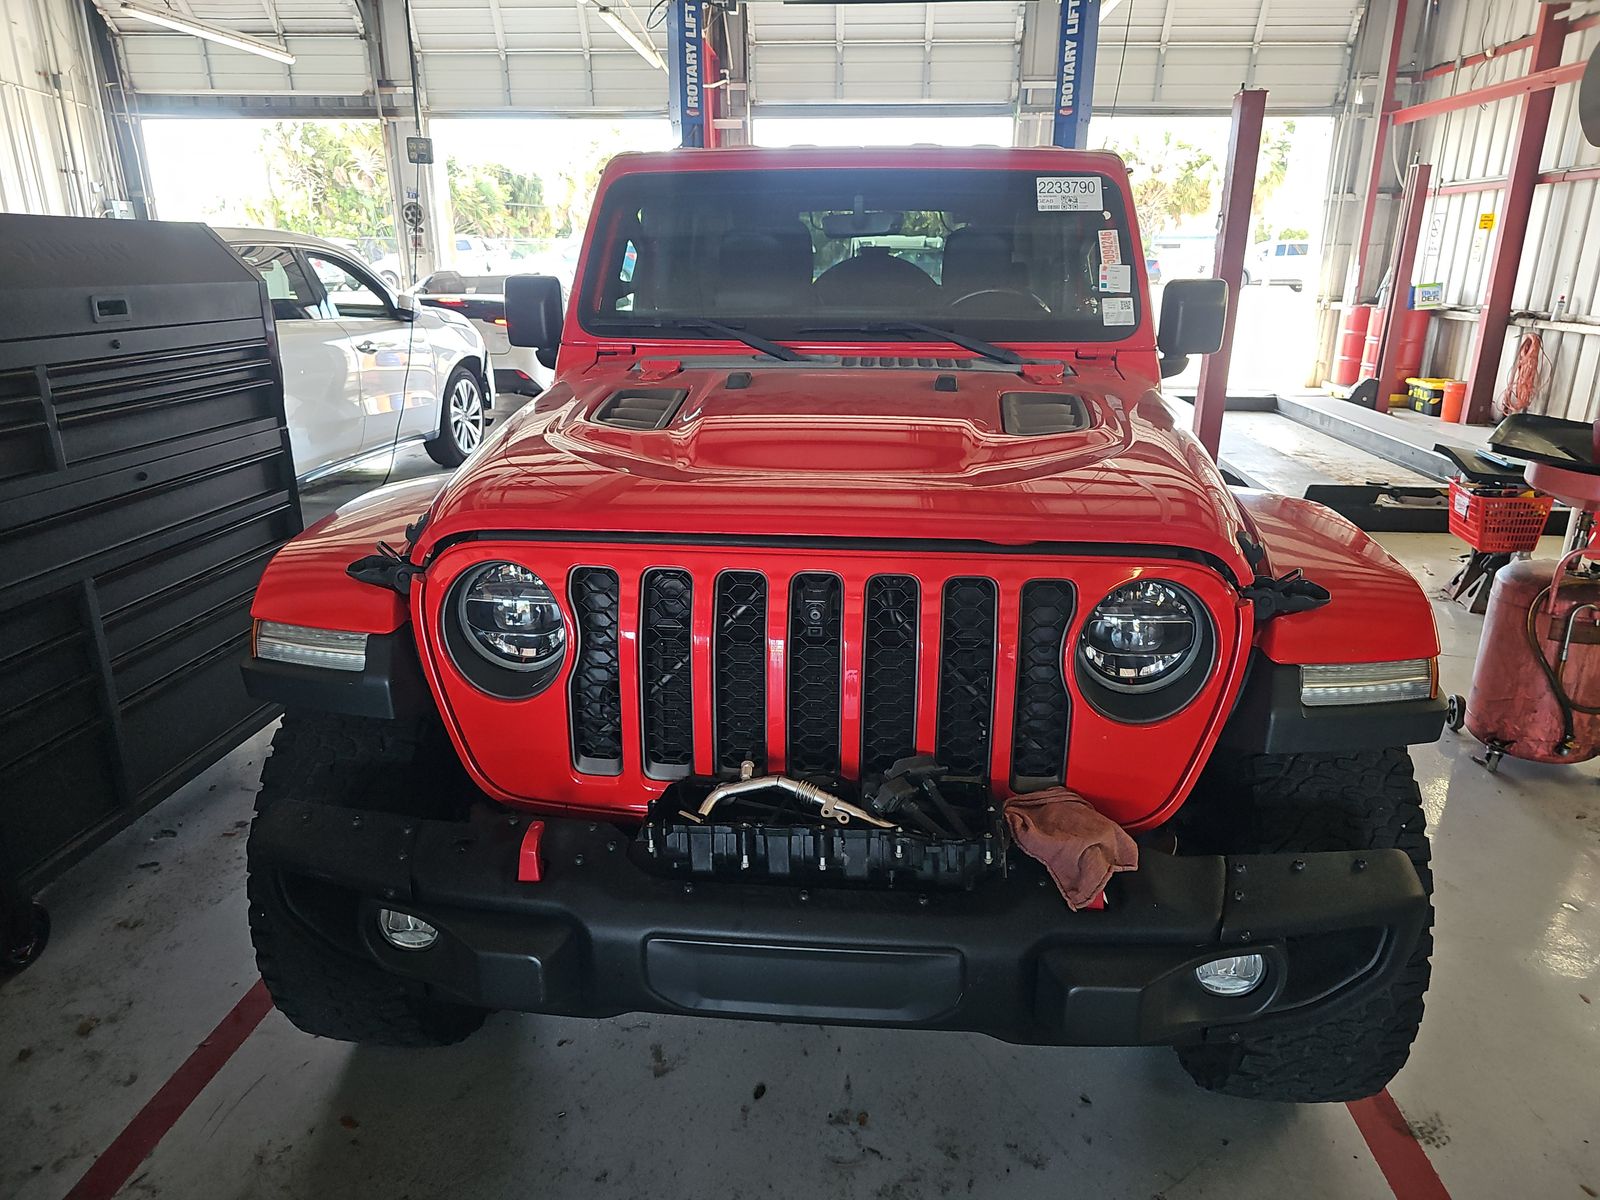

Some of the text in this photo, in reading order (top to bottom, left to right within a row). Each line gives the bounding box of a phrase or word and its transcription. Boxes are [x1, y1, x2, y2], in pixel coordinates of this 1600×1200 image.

[684, 2, 699, 108] ROTARY LIFT
[1060, 0, 1080, 107] ROTARY LIFT
[1038, 181, 1096, 194] 2233790
[1100, 231, 1116, 265] 5094246
